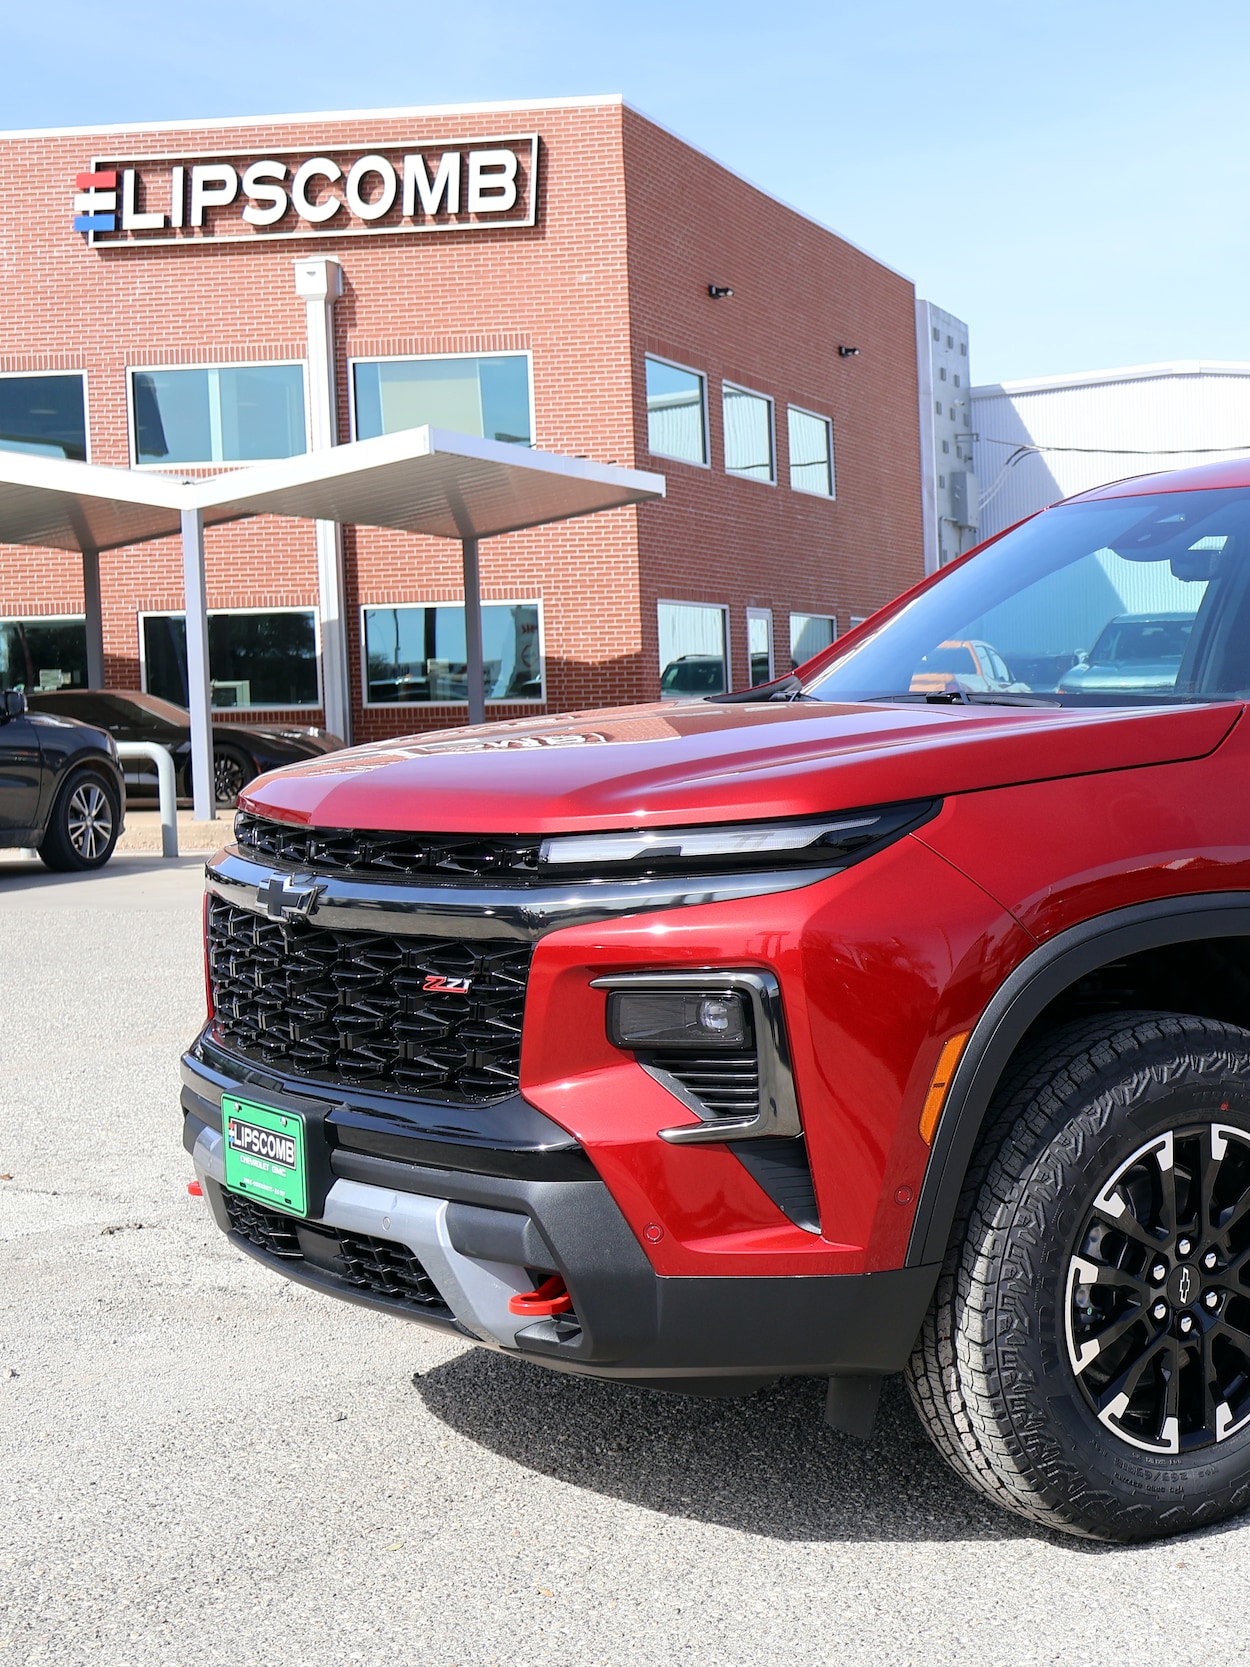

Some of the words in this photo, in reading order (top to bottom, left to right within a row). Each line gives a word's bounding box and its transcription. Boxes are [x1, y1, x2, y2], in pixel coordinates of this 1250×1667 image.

[122, 148, 519, 230] LIPSCOMB
[422, 975, 472, 994] Z71
[233, 1123, 295, 1164] LIPSCOMB
[240, 1154, 270, 1172] CHEVROLET
[271, 1164, 287, 1178] GMC
